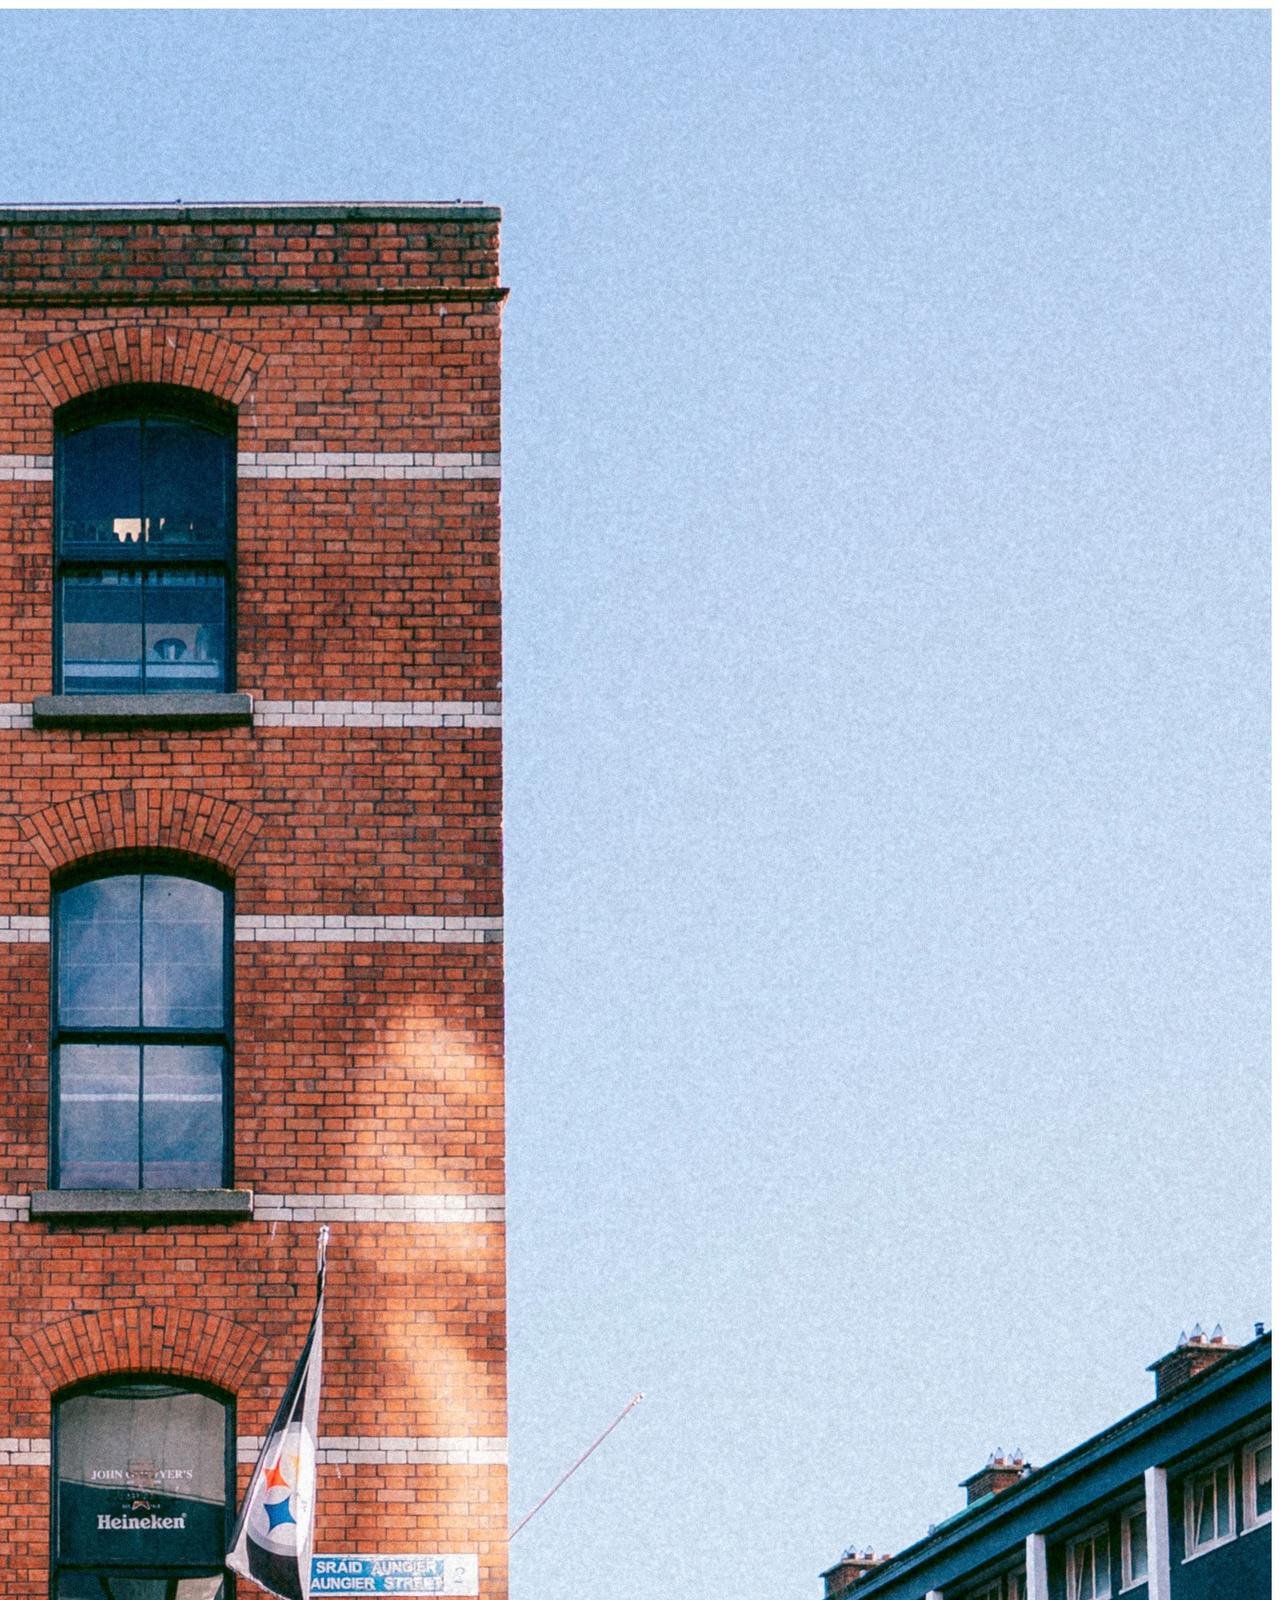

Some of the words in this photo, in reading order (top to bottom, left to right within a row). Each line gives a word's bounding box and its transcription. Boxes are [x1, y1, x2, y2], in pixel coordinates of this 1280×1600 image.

[91, 1469, 122, 1480] JOHN
[97, 1514, 186, 1529] Heineken
[371, 1560, 436, 1575] AUNGIER
[454, 1566, 466, 1584] 2
[311, 1577, 376, 1590] AUNGIER
